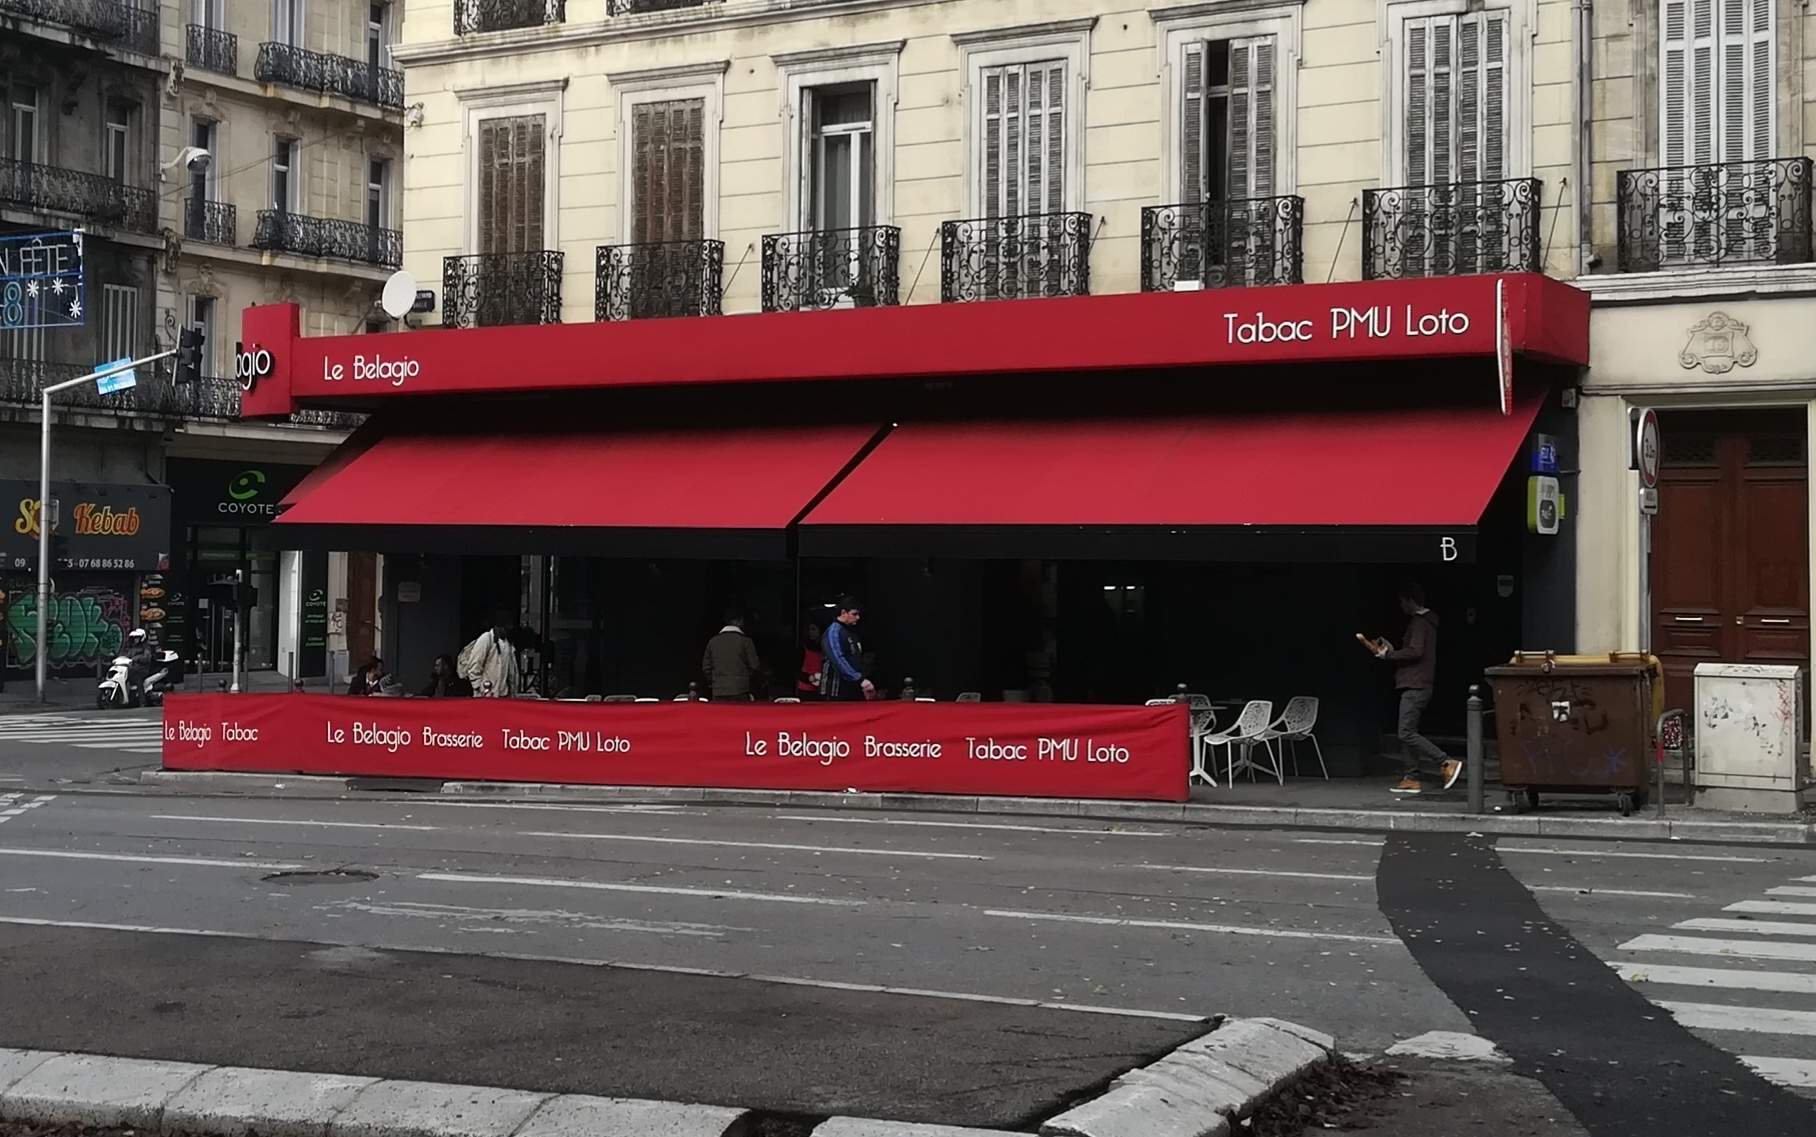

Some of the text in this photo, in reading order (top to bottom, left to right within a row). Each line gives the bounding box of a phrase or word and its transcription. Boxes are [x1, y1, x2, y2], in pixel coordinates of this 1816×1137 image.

[19, 238, 69, 277] FÊTE
[1223, 304, 1469, 344] Tabac PMU Loto
[324, 354, 420, 387] Le Belagio
[74, 502, 140, 536] Kebab
[218, 502, 274, 515] COYOTE
[14, 558, 26, 568] 09
[1439, 536, 1458, 561] B
[164, 720, 259, 748] Le Belagio Tabac
[327, 721, 631, 753] Le Belagio Brasserie Tabac PMU Loto
[746, 731, 1130, 766] Le Belagio Brasserie Tabac PMU Loto
